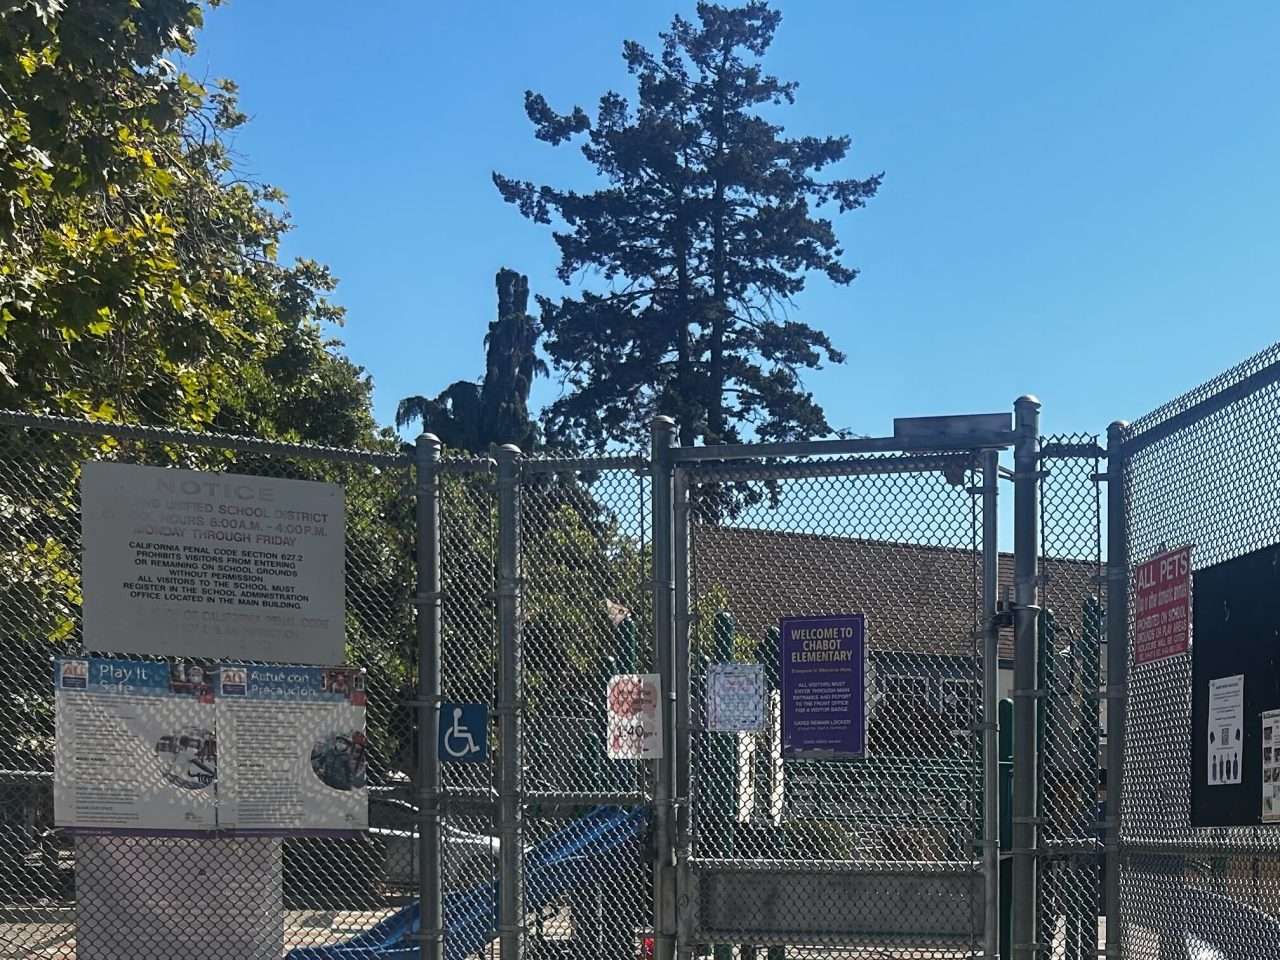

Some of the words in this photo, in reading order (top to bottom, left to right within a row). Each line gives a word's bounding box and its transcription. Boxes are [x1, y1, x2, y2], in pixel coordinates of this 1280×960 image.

[157, 477, 276, 501] NOTICE
[160, 512, 205, 526] HOURS
[218, 504, 271, 518] SCHOOL
[274, 508, 328, 523] DISTRICT
[190, 528, 252, 543] THROUGH
[256, 534, 297, 547] FRIDAY
[128, 541, 180, 551] CALIFORNIA
[183, 545, 211, 554] PENAL
[214, 548, 238, 556] CODE
[241, 550, 278, 559] SECTION
[281, 553, 303, 561] 627.2
[136, 550, 181, 560] PROHIBITS
[184, 553, 224, 563] VISITORS
[227, 556, 251, 566] FROM
[254, 559, 296, 569] ENTERING
[134, 558, 148, 566] OR
[151, 559, 198, 570] REMAINING
[201, 563, 215, 571] ON
[217, 565, 253, 574] SCHOOL
[257, 567, 298, 577] GROUNDS
[169, 569, 208, 579] WITHOUT
[211, 572, 264, 582] PERMISSION
[1138, 565, 1157, 592] ALL
[1160, 552, 1188, 583] PETS
[123, 582, 166, 592] REGISTER
[181, 586, 198, 594] THE
[201, 587, 237, 597] SCHOOL
[240, 590, 309, 602] ADMINISTRATION
[137, 575, 153, 583] ALL
[156, 576, 195, 586] VISITORS
[199, 579, 210, 587] TO
[214, 580, 230, 588] THE
[233, 582, 269, 591] SCHOOL
[272, 584, 295, 593] MUST
[130, 590, 161, 599] OFFICE
[164, 593, 204, 602] LOCATED
[219, 597, 235, 605] THE
[238, 598, 259, 606] MAIN
[791, 628, 839, 640] WELCOME
[840, 627, 853, 638] TO
[803, 640, 842, 651] CHABOT
[791, 650, 853, 663] ELEMENTARY
[100, 664, 132, 682] Play
[137, 666, 148, 680] It
[288, 673, 310, 683] con
[100, 680, 133, 694] Safe
[251, 684, 316, 697] Precaución
